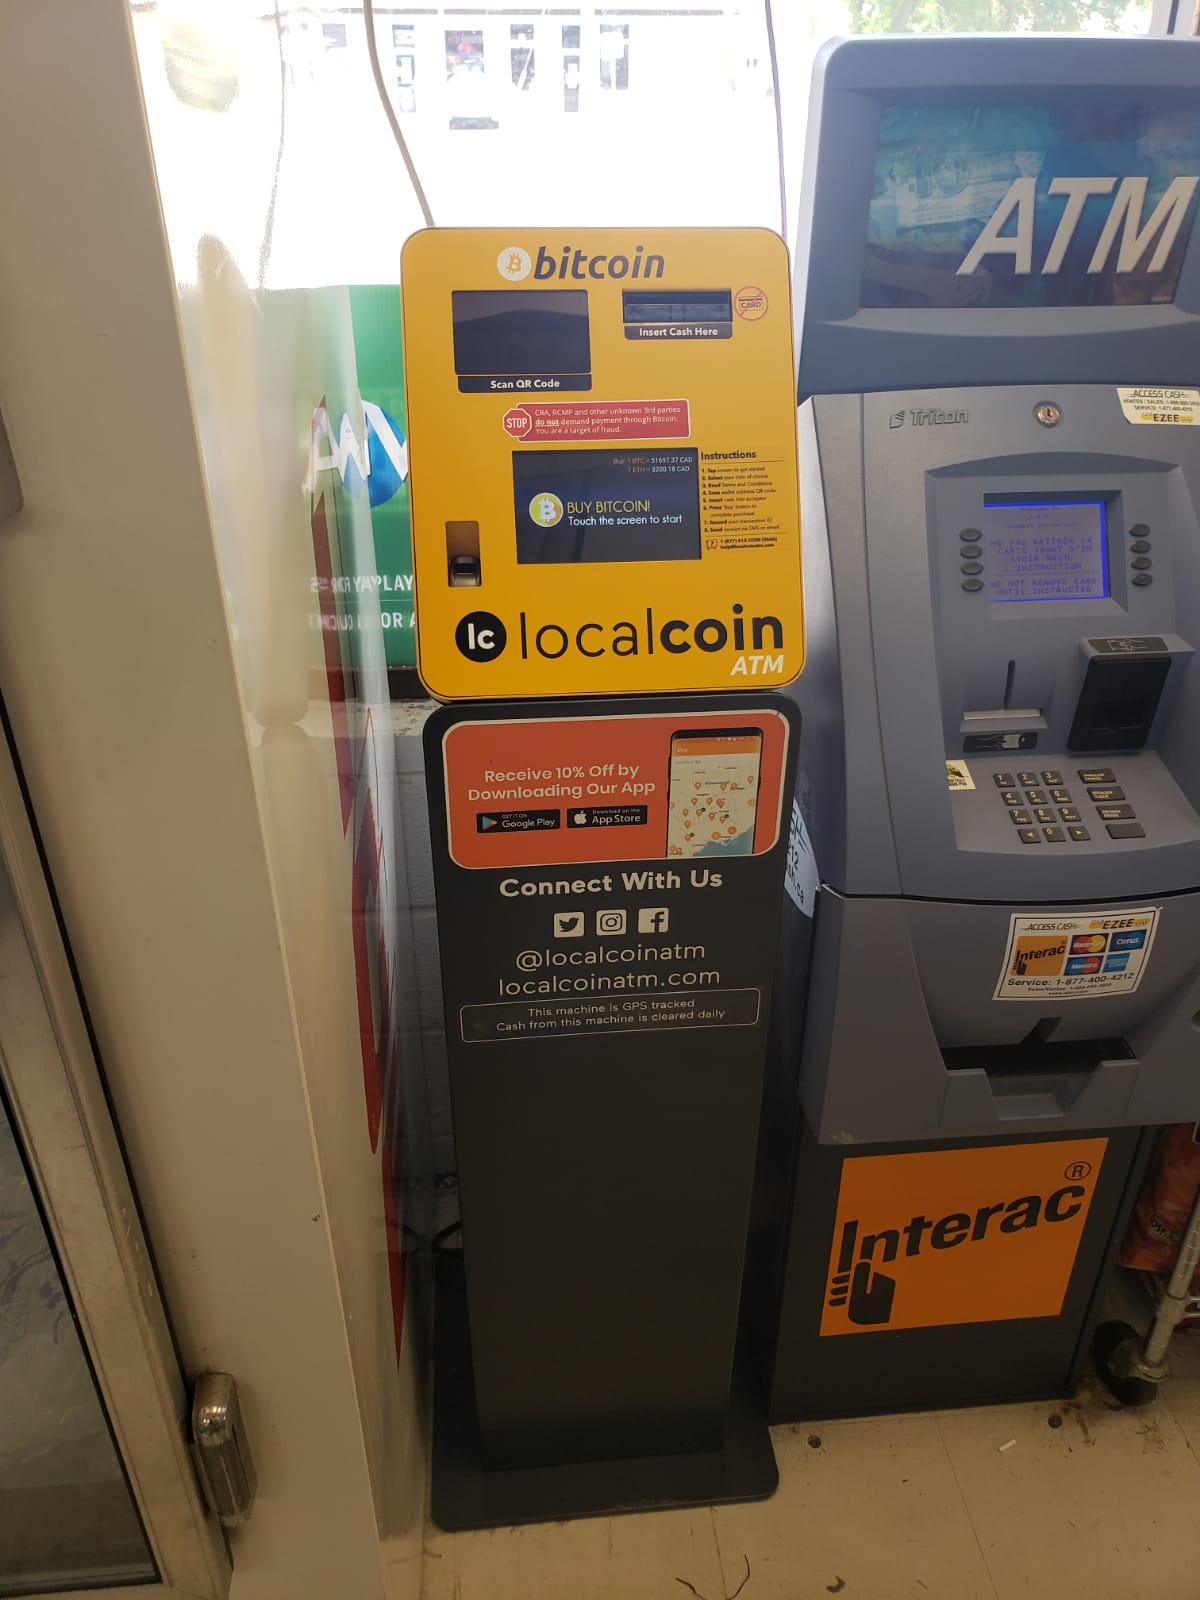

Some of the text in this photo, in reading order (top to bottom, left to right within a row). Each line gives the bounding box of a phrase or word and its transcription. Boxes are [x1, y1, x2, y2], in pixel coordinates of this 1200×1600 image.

[955, 176, 1200, 276] ATM
[533, 245, 665, 280] bitcoin
[741, 301, 762, 309] CARD
[639, 327, 718, 337] Insert Cash Here
[490, 379, 560, 389] Scan QR Code
[1134, 389, 1163, 398] ACCESS
[534, 406, 681, 417] CRA, RCMP and other unknown 3rd parties
[910, 407, 969, 427] Triton
[1154, 413, 1179, 422] EZEE
[506, 417, 528, 429] STOP
[535, 418, 546, 427] do
[546, 418, 560, 427] not
[560, 417, 590, 426] demand
[591, 416, 622, 427] payment
[623, 415, 651, 426] through
[535, 427, 550, 435] You
[569, 426, 591, 436] target
[600, 425, 622, 433] fraud.
[612, 457, 625, 466] Buy
[701, 450, 757, 460] Instructions
[567, 500, 651, 514] BUY BITCOIN!
[568, 514, 683, 526] Touch the screen to start
[1031, 577, 1067, 586] REMOVE
[1073, 576, 1097, 585] CARD
[995, 585, 1092, 596] UNTIL INSTRUCTED
[467, 623, 495, 650] lc
[519, 603, 784, 660] localcoin
[730, 654, 785, 676] ATM
[484, 763, 640, 783] Receive 10% Off by
[468, 781, 656, 801] Downloading Our App
[501, 817, 556, 830] Google Play
[591, 814, 641, 826] App Store
[499, 869, 724, 898] Connect With Us
[1027, 923, 1056, 931] ACCESS
[1101, 918, 1135, 930] EZEE
[1116, 936, 1141, 946] Cirrus
[515, 943, 706, 973] @localcoinatm
[1015, 944, 1066, 963] Interac
[1071, 962, 1098, 971] Maestro
[499, 970, 721, 996] localcoinatm.com
[1007, 978, 1052, 987] Service:
[1055, 972, 1135, 986] 1-877-400-4212
[527, 998, 695, 1018] This machine is GPS tracked
[496, 1008, 725, 1032] Cash from this machine is cleared daily
[837, 1185, 1086, 1274] Interac
